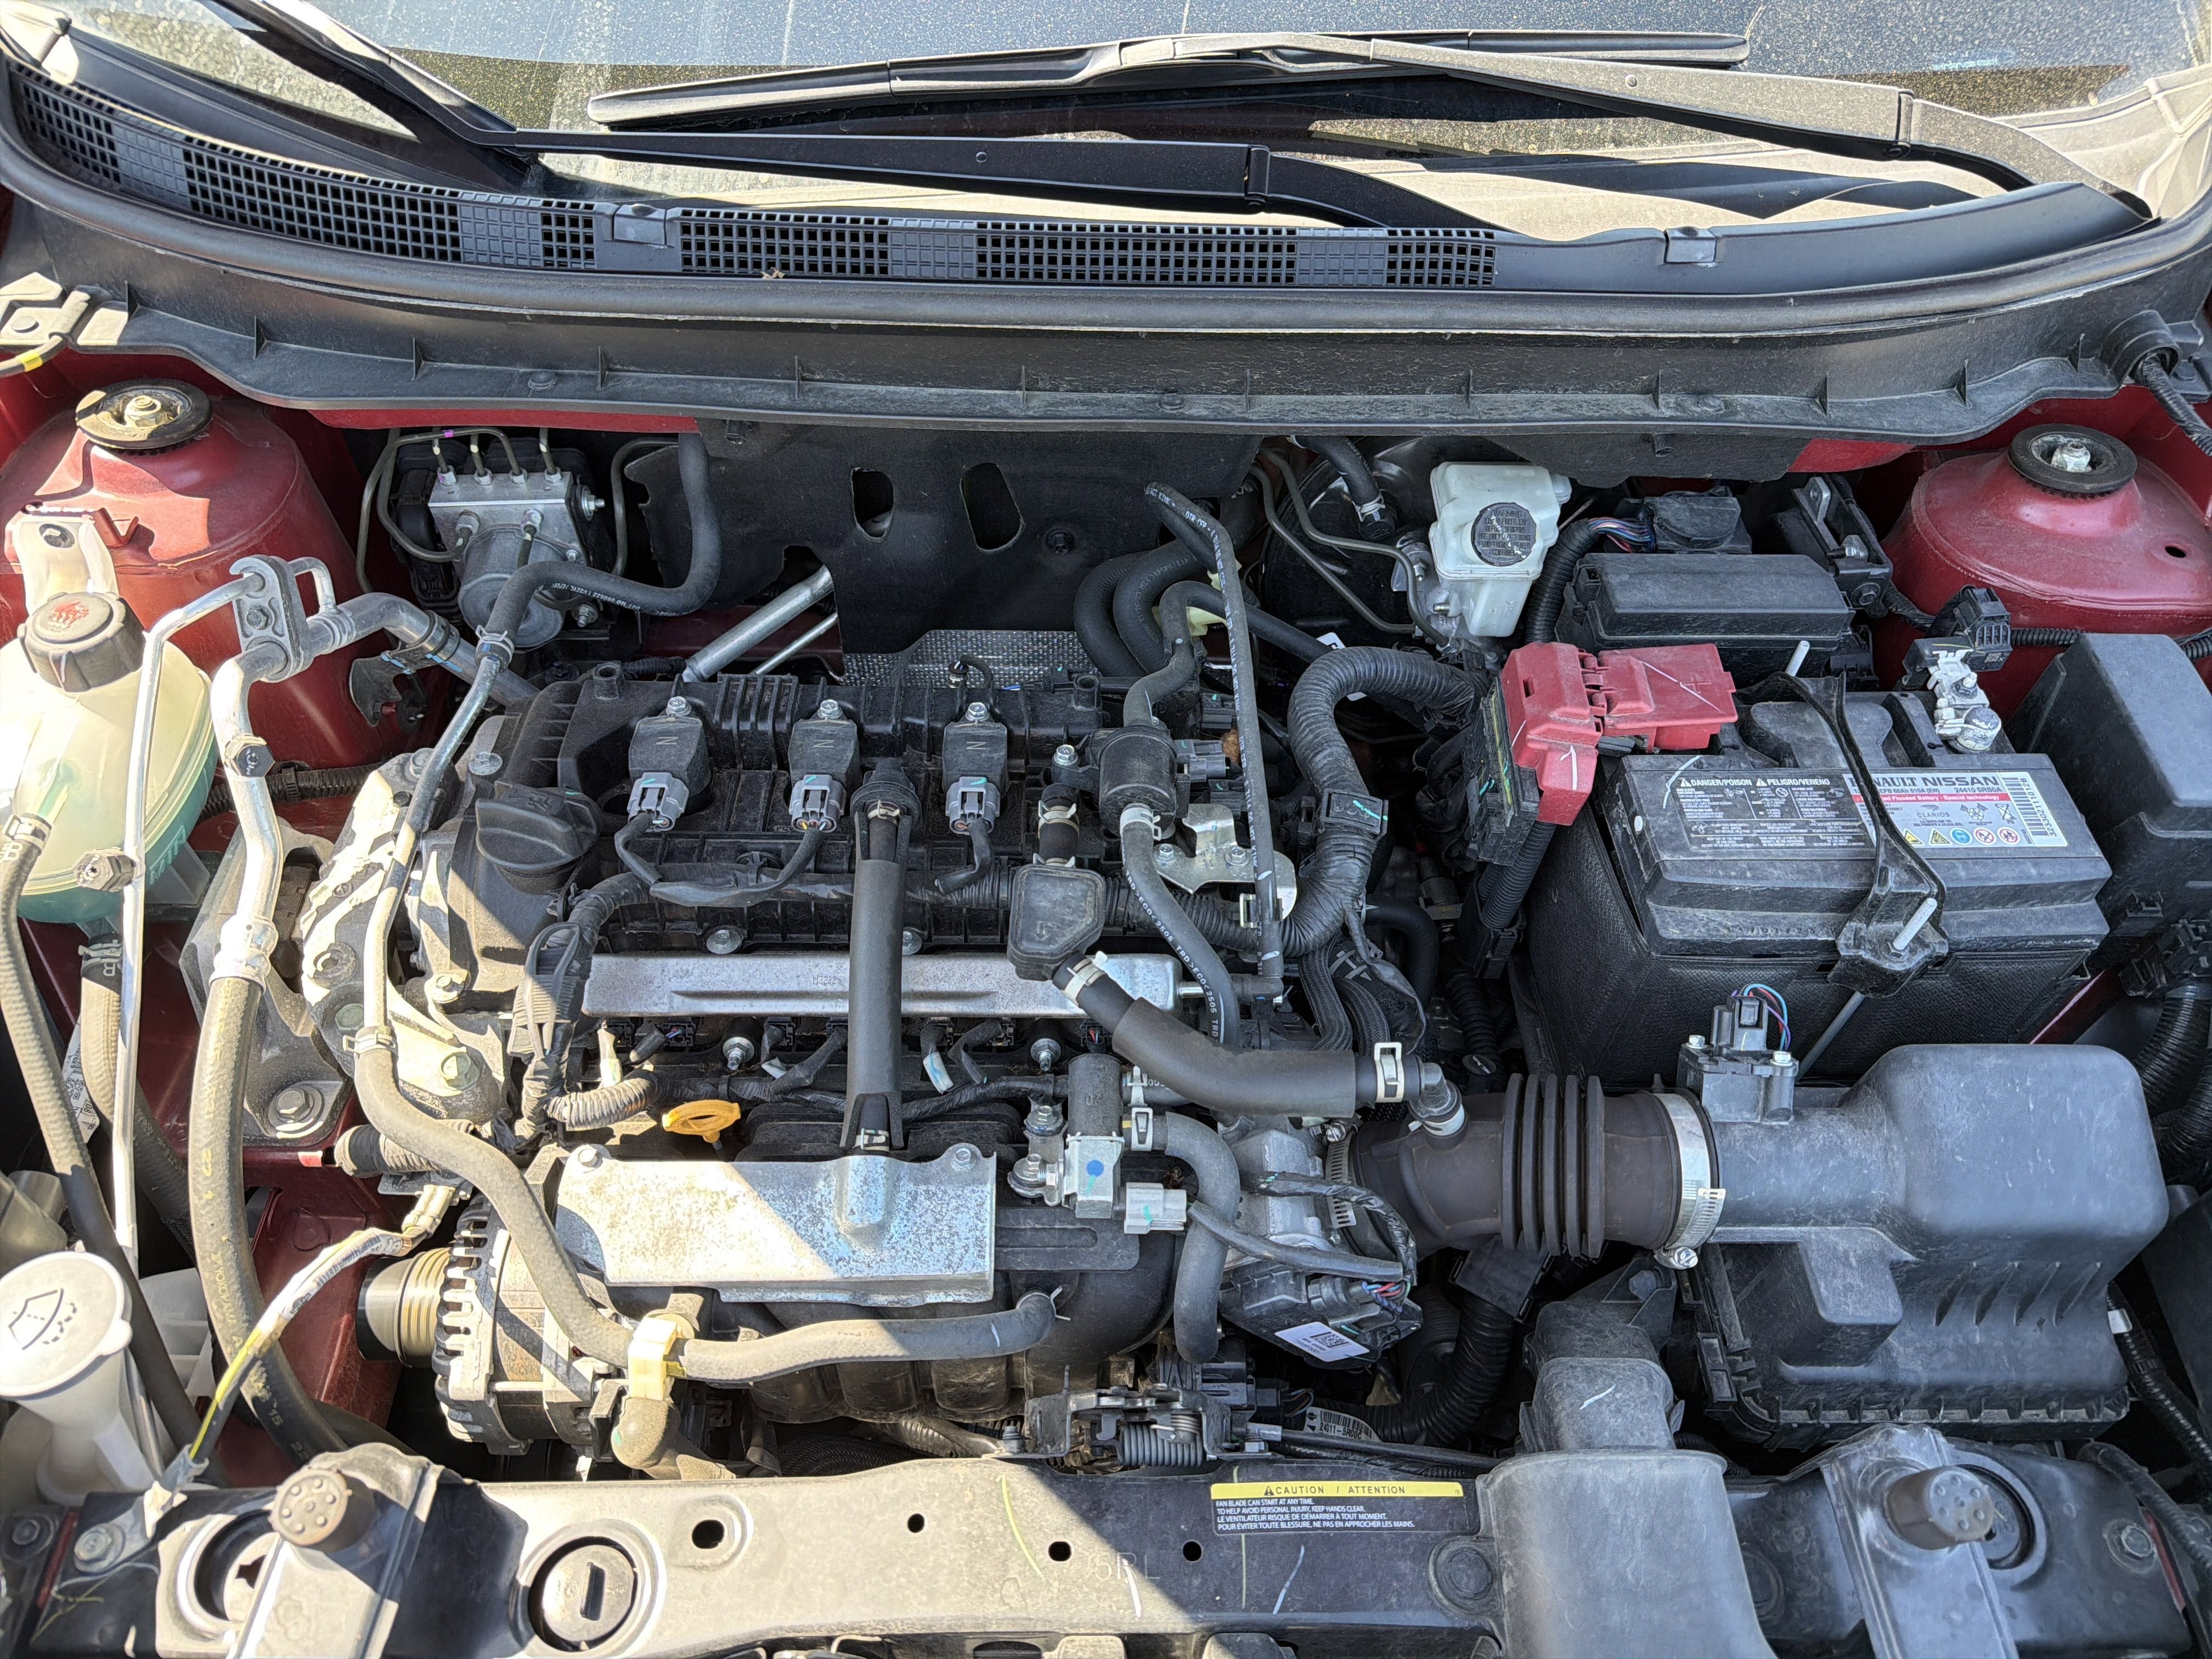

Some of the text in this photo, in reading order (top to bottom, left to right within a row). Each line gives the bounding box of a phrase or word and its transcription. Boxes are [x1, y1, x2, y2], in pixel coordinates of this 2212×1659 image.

[1848, 776, 2000, 787] NAULT NISSAN
[218, 1267, 238, 1327] YOKOHAMA
[1276, 1486, 1324, 1494] CAUTION
[1348, 1486, 1406, 1494] ATTENTION
[1301, 1512, 1334, 1520] DÉMARRER
[1237, 1521, 1259, 1530] ÉVITER
